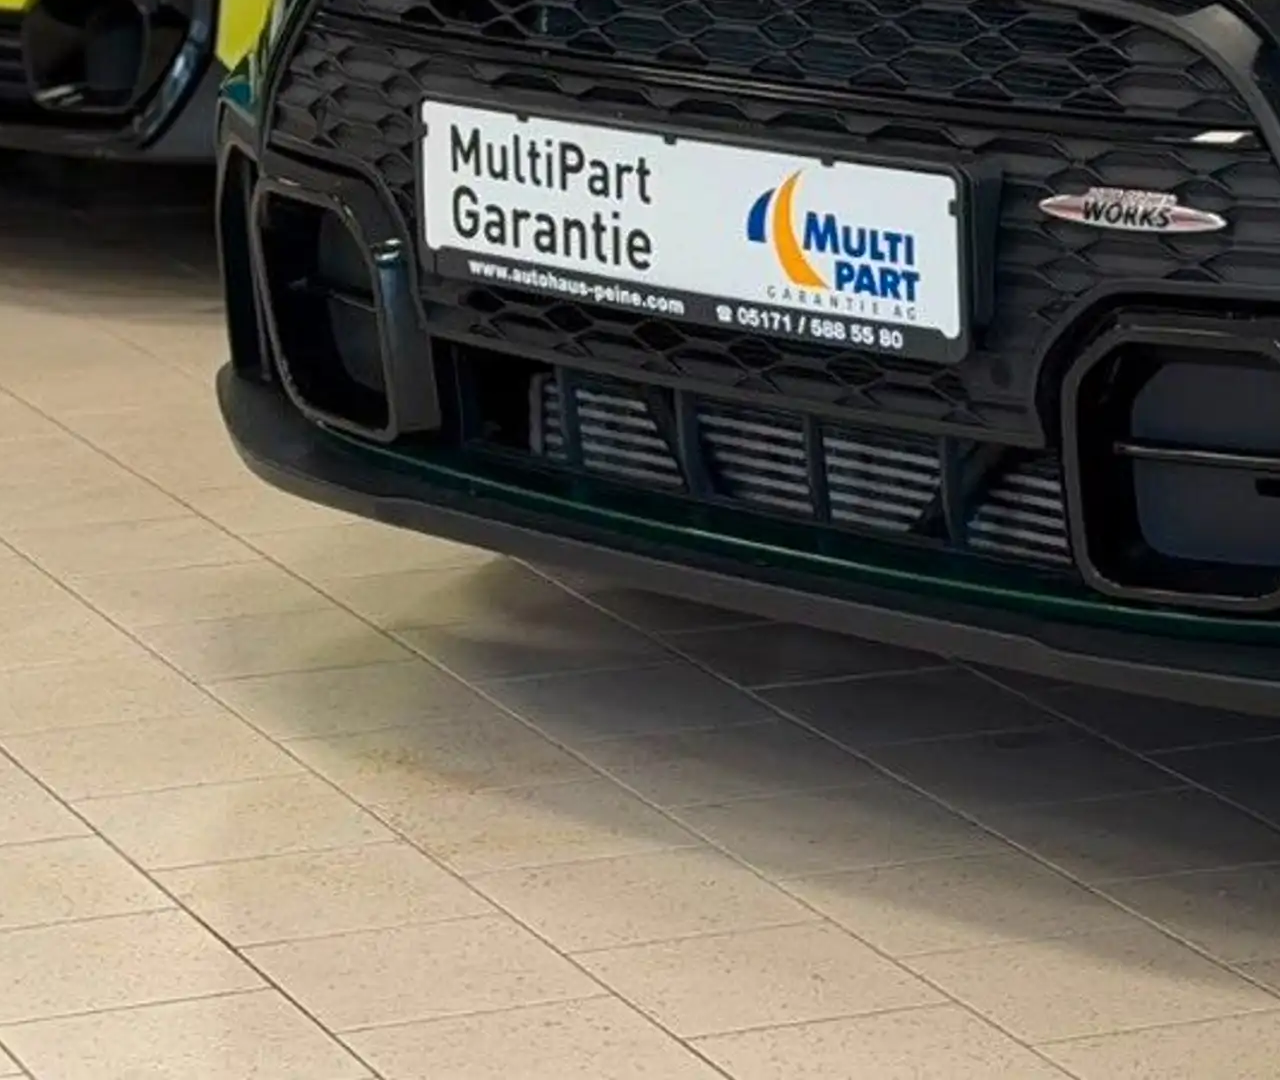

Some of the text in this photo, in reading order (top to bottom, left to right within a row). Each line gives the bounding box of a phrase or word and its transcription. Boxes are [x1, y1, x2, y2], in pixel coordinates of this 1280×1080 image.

[450, 123, 652, 205] MultiPart
[451, 185, 653, 270] Garantie
[803, 210, 915, 266] MULTI
[1082, 200, 1171, 229] WORKS
[467, 259, 686, 315] www.autohaus-peine.com
[766, 285, 917, 320] GARANTIE AG
[834, 260, 921, 302] PART
[736, 305, 792, 333] 05171
[810, 318, 847, 340] 588
[850, 325, 875, 346] 55
[879, 328, 904, 350] 80
